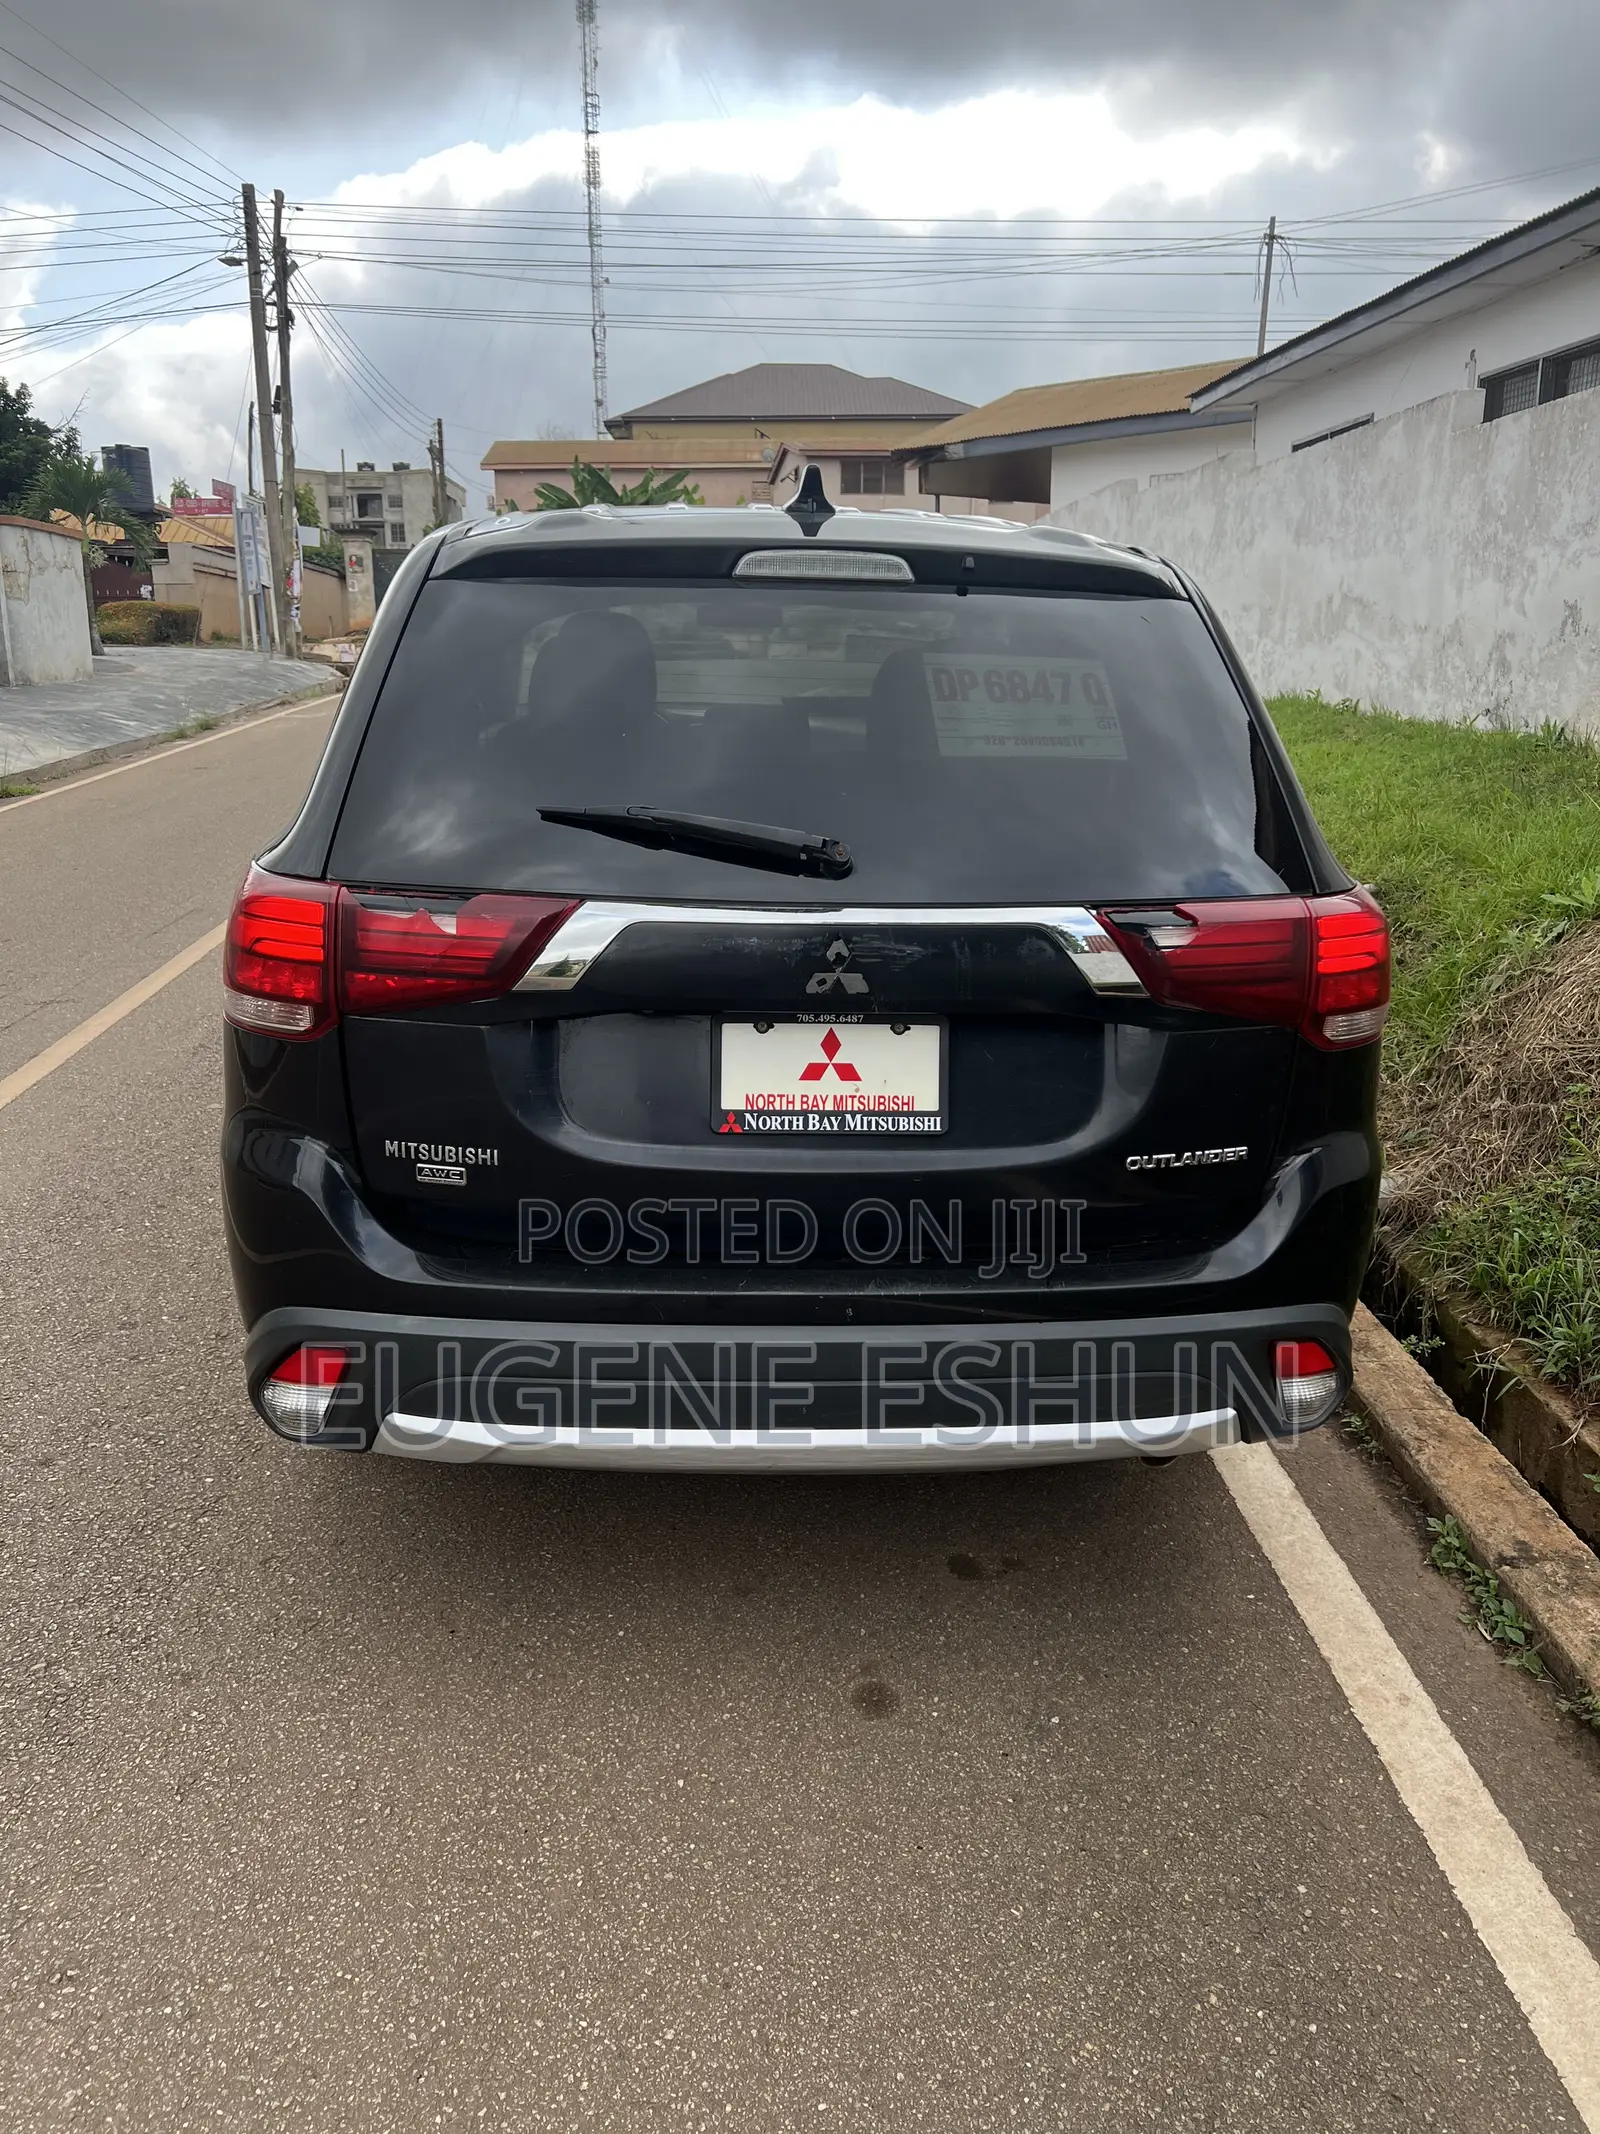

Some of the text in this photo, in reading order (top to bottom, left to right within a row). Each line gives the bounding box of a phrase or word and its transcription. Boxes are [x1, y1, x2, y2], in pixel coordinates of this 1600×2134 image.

[931, 667, 979, 703] DP
[983, 669, 1073, 706] 6847
[796, 1013, 864, 1024] 705.495.6487
[745, 1093, 915, 1112] NORTH BAY MITSUBISHI
[743, 1113, 942, 1132] NORTH BAY MITSUBISHI
[385, 1139, 499, 1166] MITSUBISHI
[1126, 1146, 1249, 1171] OUTLANDER
[420, 1168, 461, 1179] AWC
